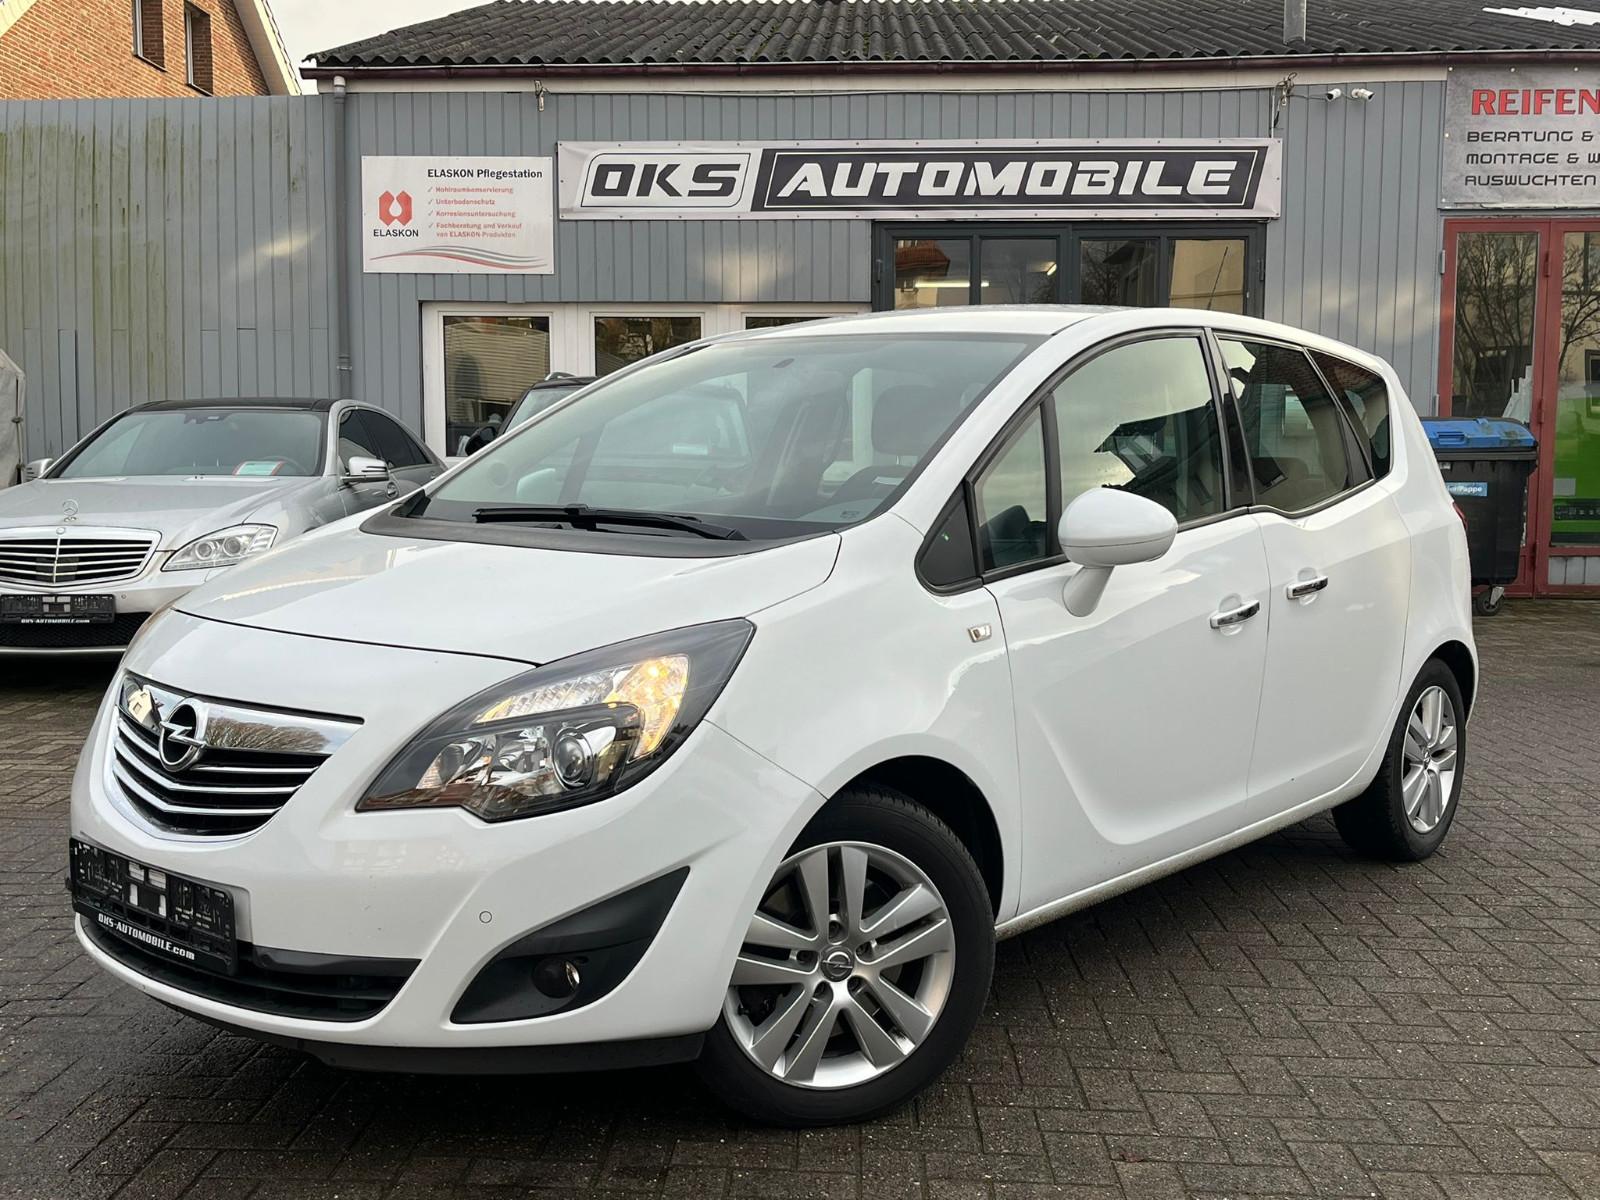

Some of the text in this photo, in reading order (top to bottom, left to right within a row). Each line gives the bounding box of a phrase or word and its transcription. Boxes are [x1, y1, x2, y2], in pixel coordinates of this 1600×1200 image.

[1471, 89, 1600, 115] REIFEN
[1467, 131, 1594, 142] BERATUNG &
[1466, 153, 1559, 165] MONTAGE
[1567, 153, 1579, 164] &
[427, 169, 543, 180] ELASKON Pflegestation
[591, 160, 1237, 197] OKS AUTOMOBILE
[1465, 175, 1596, 186] AUSWUCHTEN
[436, 222, 482, 230] Fachberatung
[373, 229, 419, 237] ELASKON
